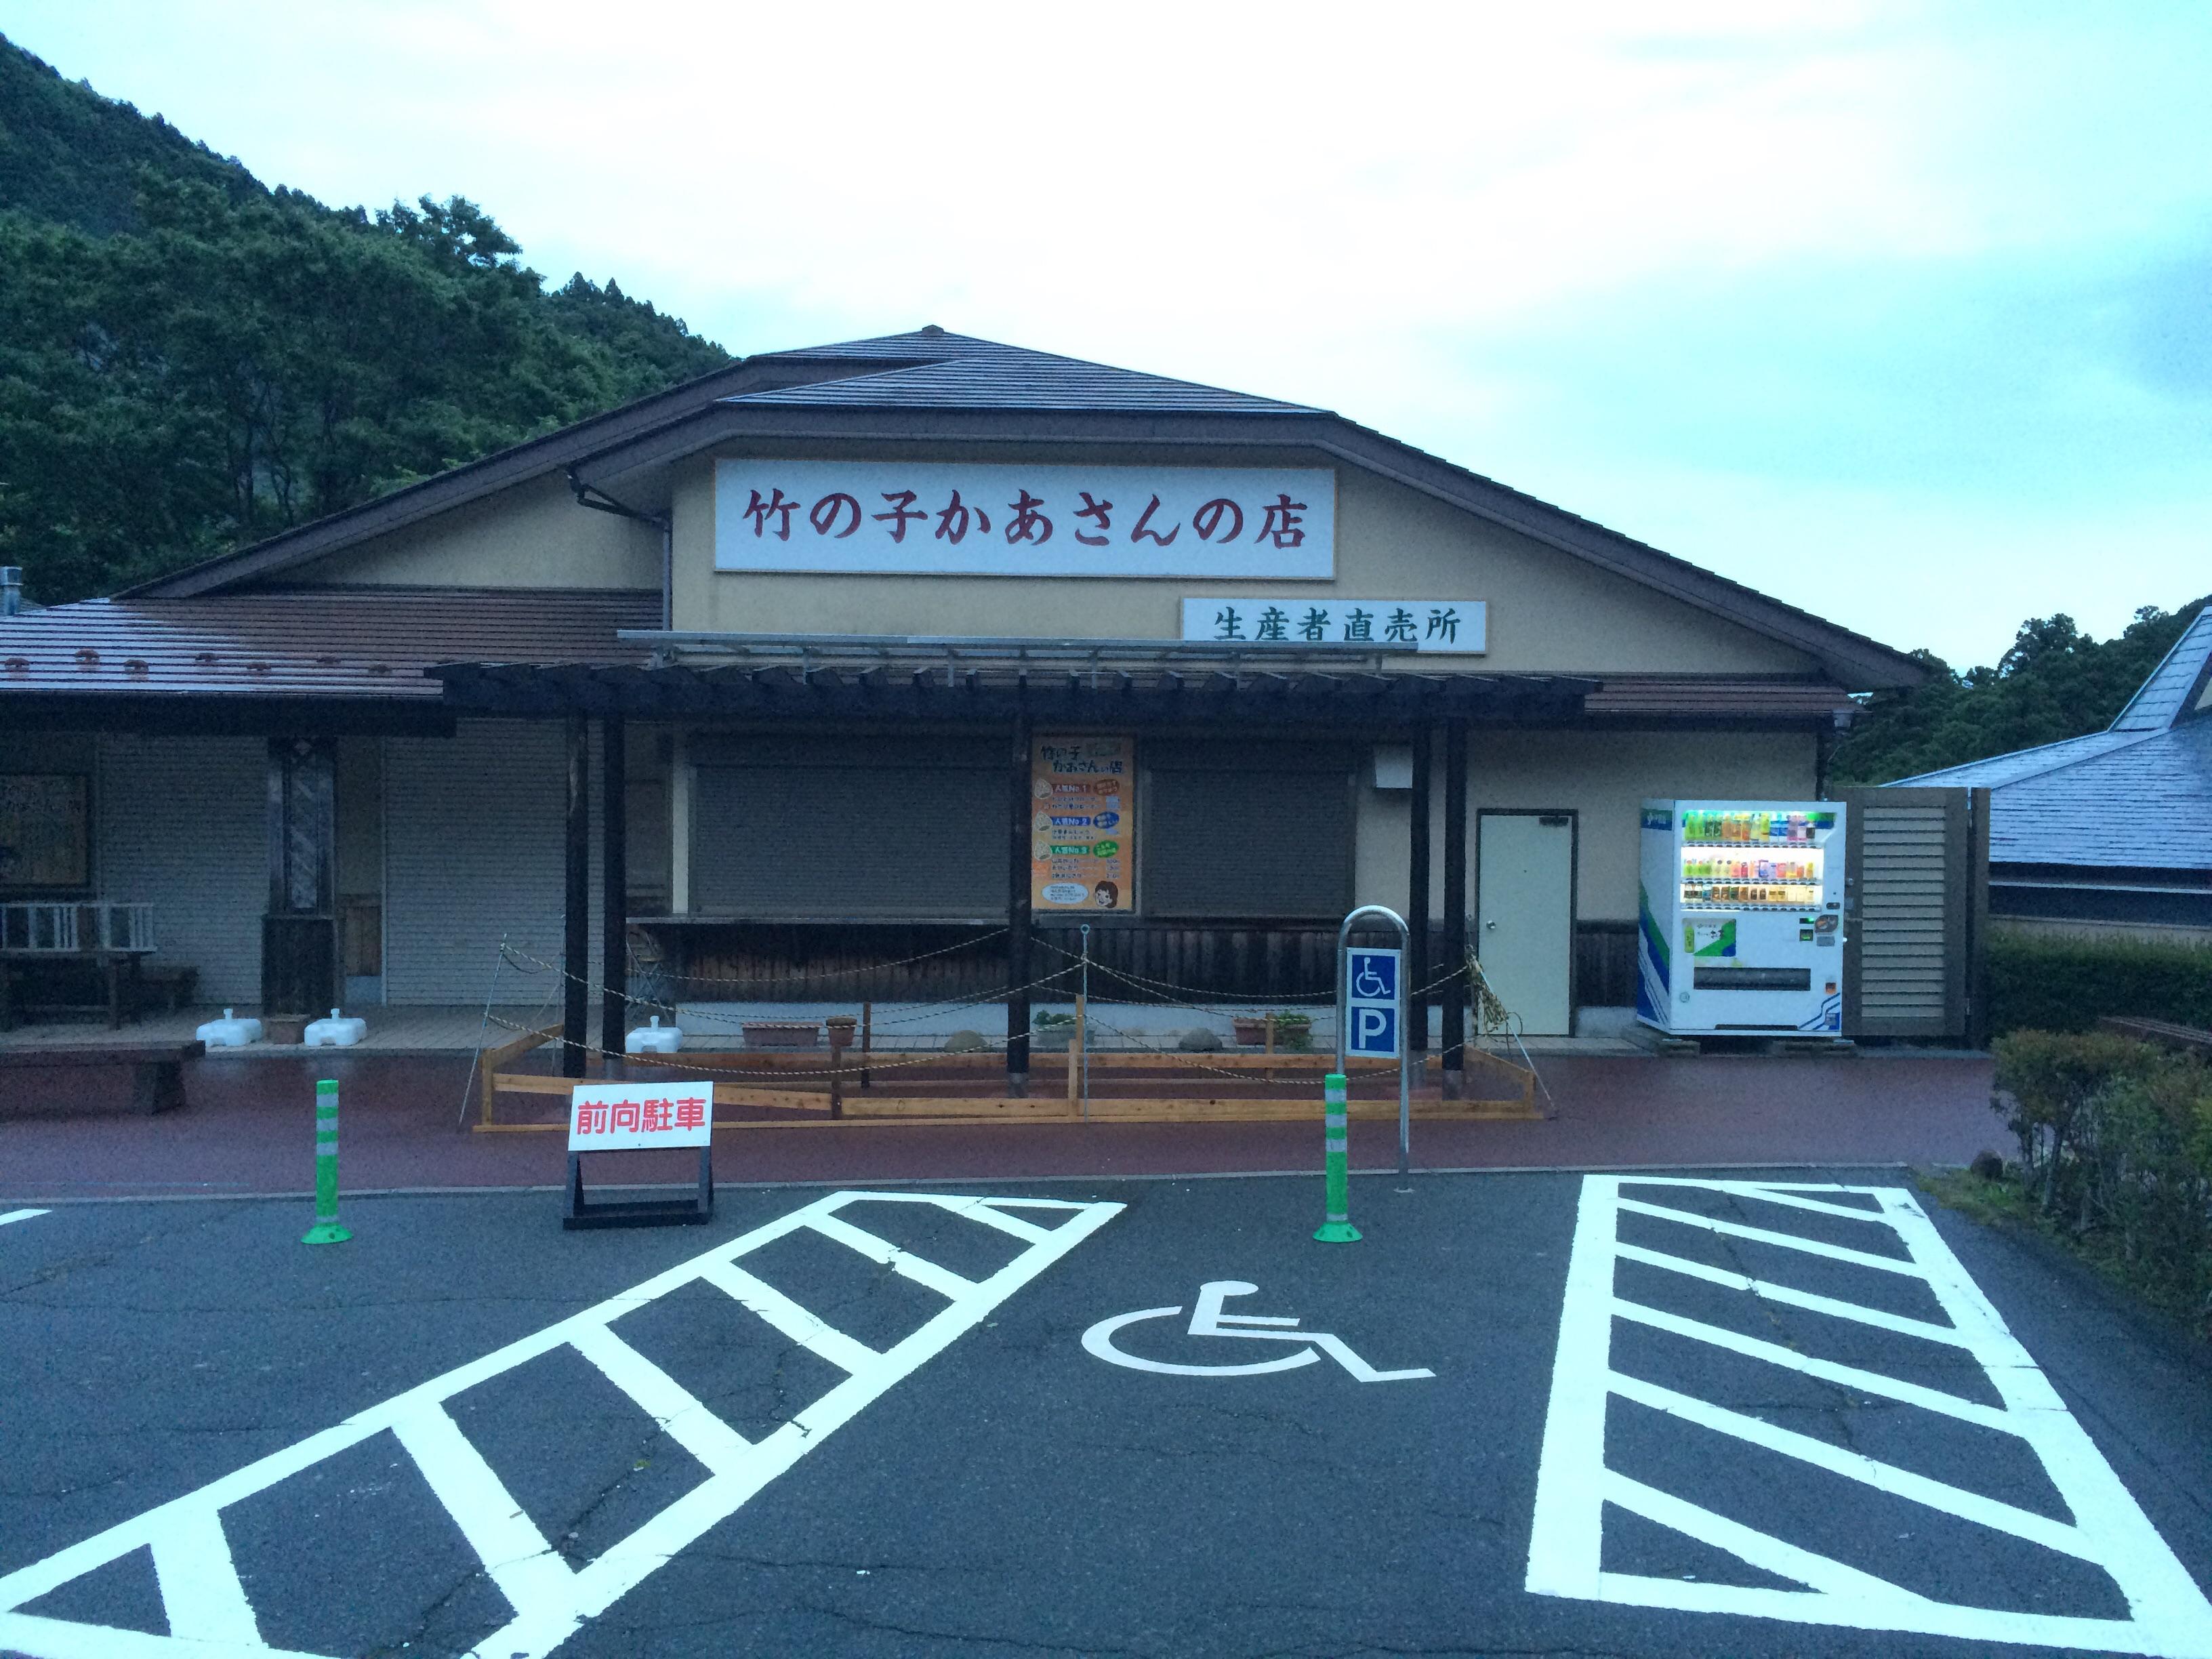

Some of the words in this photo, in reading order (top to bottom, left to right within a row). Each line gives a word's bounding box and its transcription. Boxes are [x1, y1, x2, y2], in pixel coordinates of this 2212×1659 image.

[743, 488, 1309, 550] 竹の子かあさんの店
[1214, 606, 1461, 644] 生産者直売所
[1358, 1008, 1387, 1049] P
[576, 1097, 706, 1135] 前向駐車
